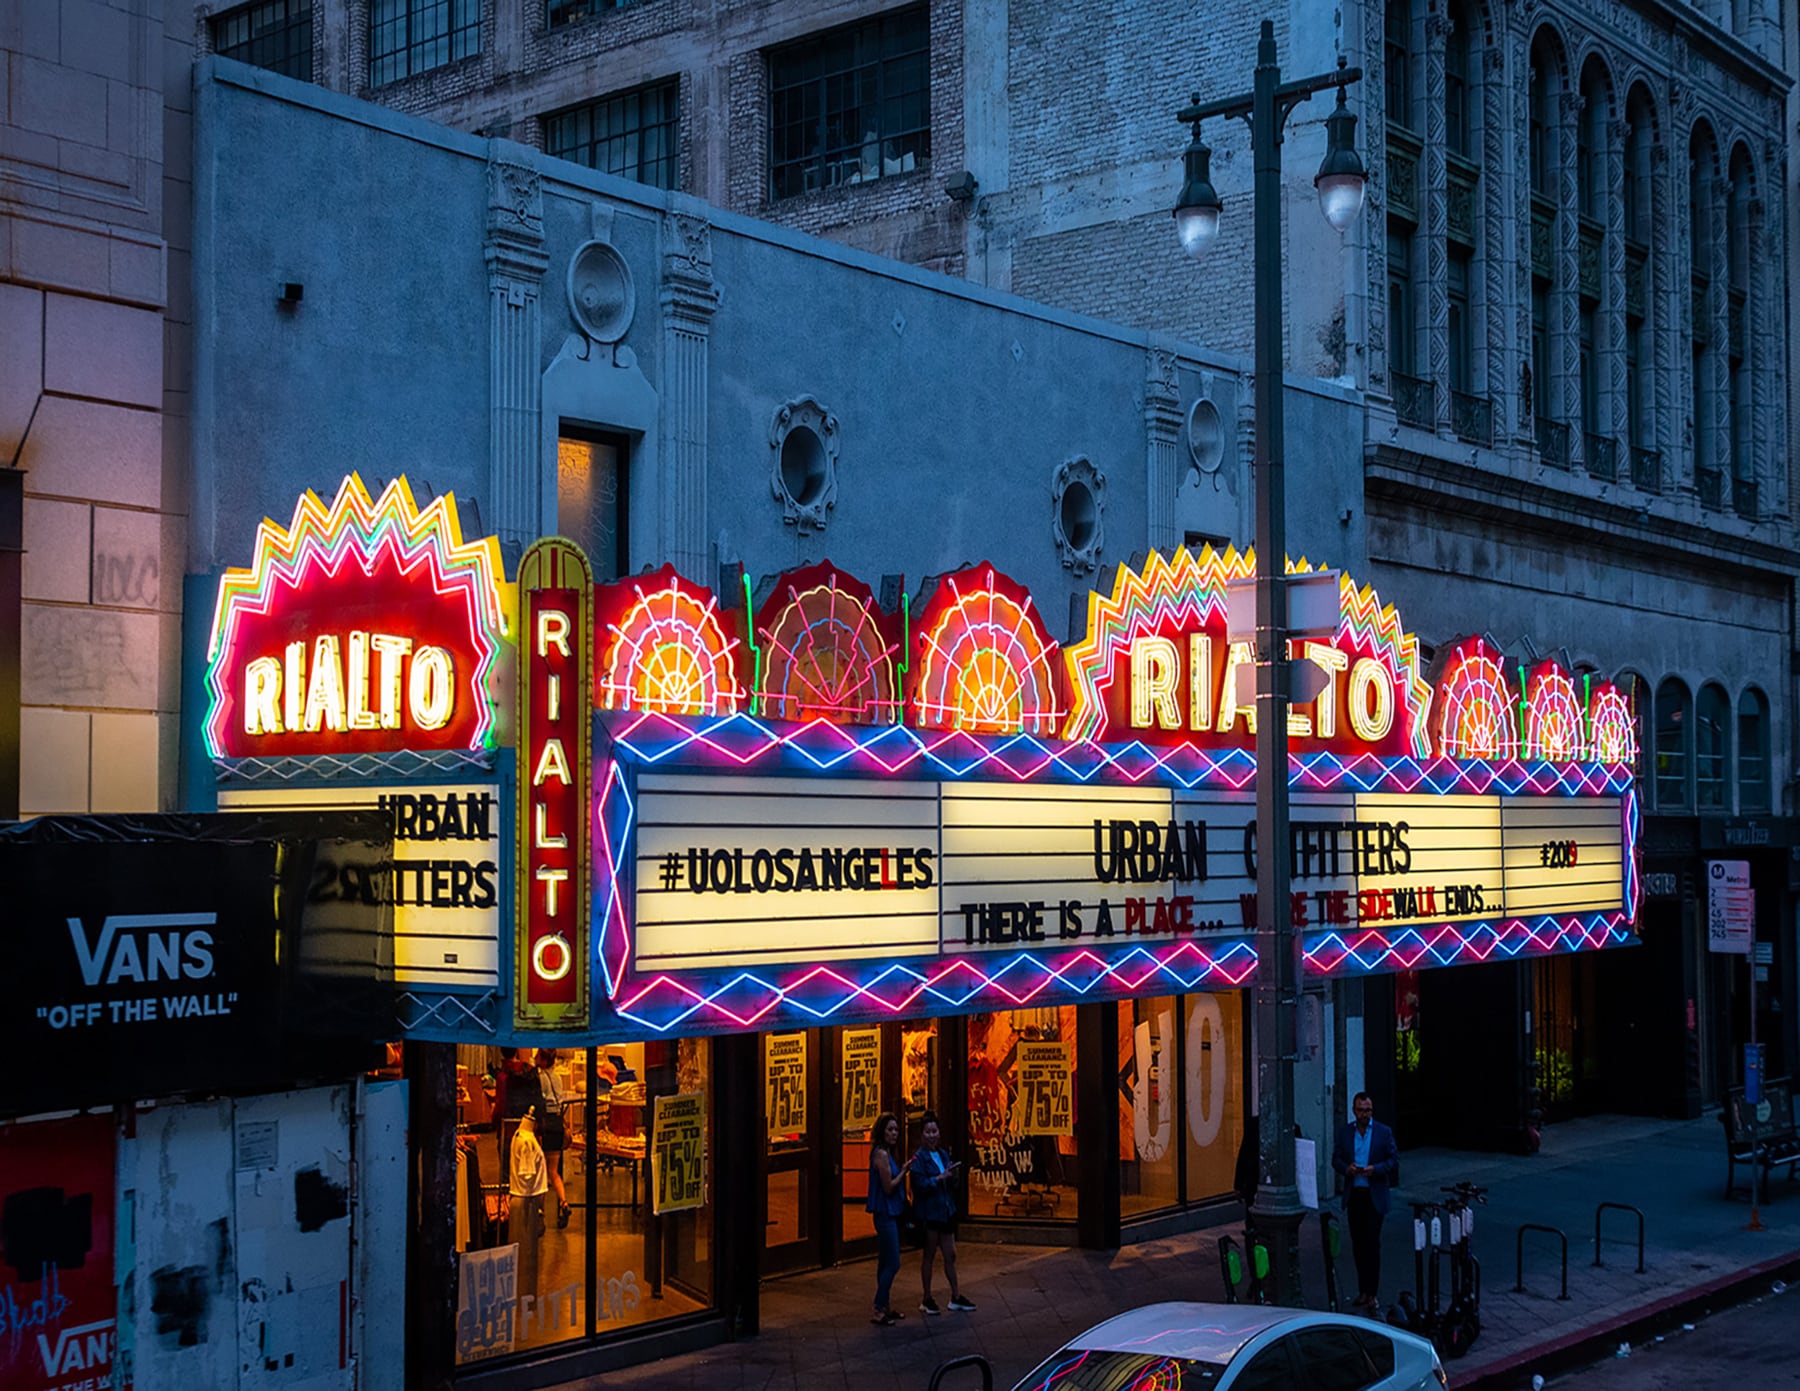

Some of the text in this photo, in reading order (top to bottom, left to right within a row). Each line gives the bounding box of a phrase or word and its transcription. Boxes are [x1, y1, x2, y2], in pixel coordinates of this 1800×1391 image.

[245, 630, 455, 735] RIALTO
[532, 610, 572, 980] RIALTO
[1094, 819, 1412, 883] URBAN OTFITTERS
[1540, 840, 1578, 868] #2019
[659, 847, 933, 893] #UOLOSANGELES
[960, 901, 1045, 944] THERE
[1060, 900, 1082, 939] IS
[1095, 898, 1114, 937] A
[1315, 889, 1350, 924] THE
[1358, 886, 1437, 922] SIDEWALK
[66, 912, 217, 986] VANS
[108, 998, 158, 1023] THE
[770, 1064, 802, 1076] UP TO
[845, 1058, 877, 1070] UP TO
[1022, 1070, 1068, 1080] UP TO
[770, 1076, 803, 1129] 75%
[845, 1070, 878, 1120] 75%
[866, 1104, 878, 1118] OFF
[1022, 1080, 1069, 1128] 75%
[657, 1127, 700, 1142] UP TO
[791, 1110, 804, 1126] OFF
[1052, 1114, 1070, 1128] OFF
[656, 1140, 700, 1204] 75%
[686, 1181, 700, 1199] OFF
